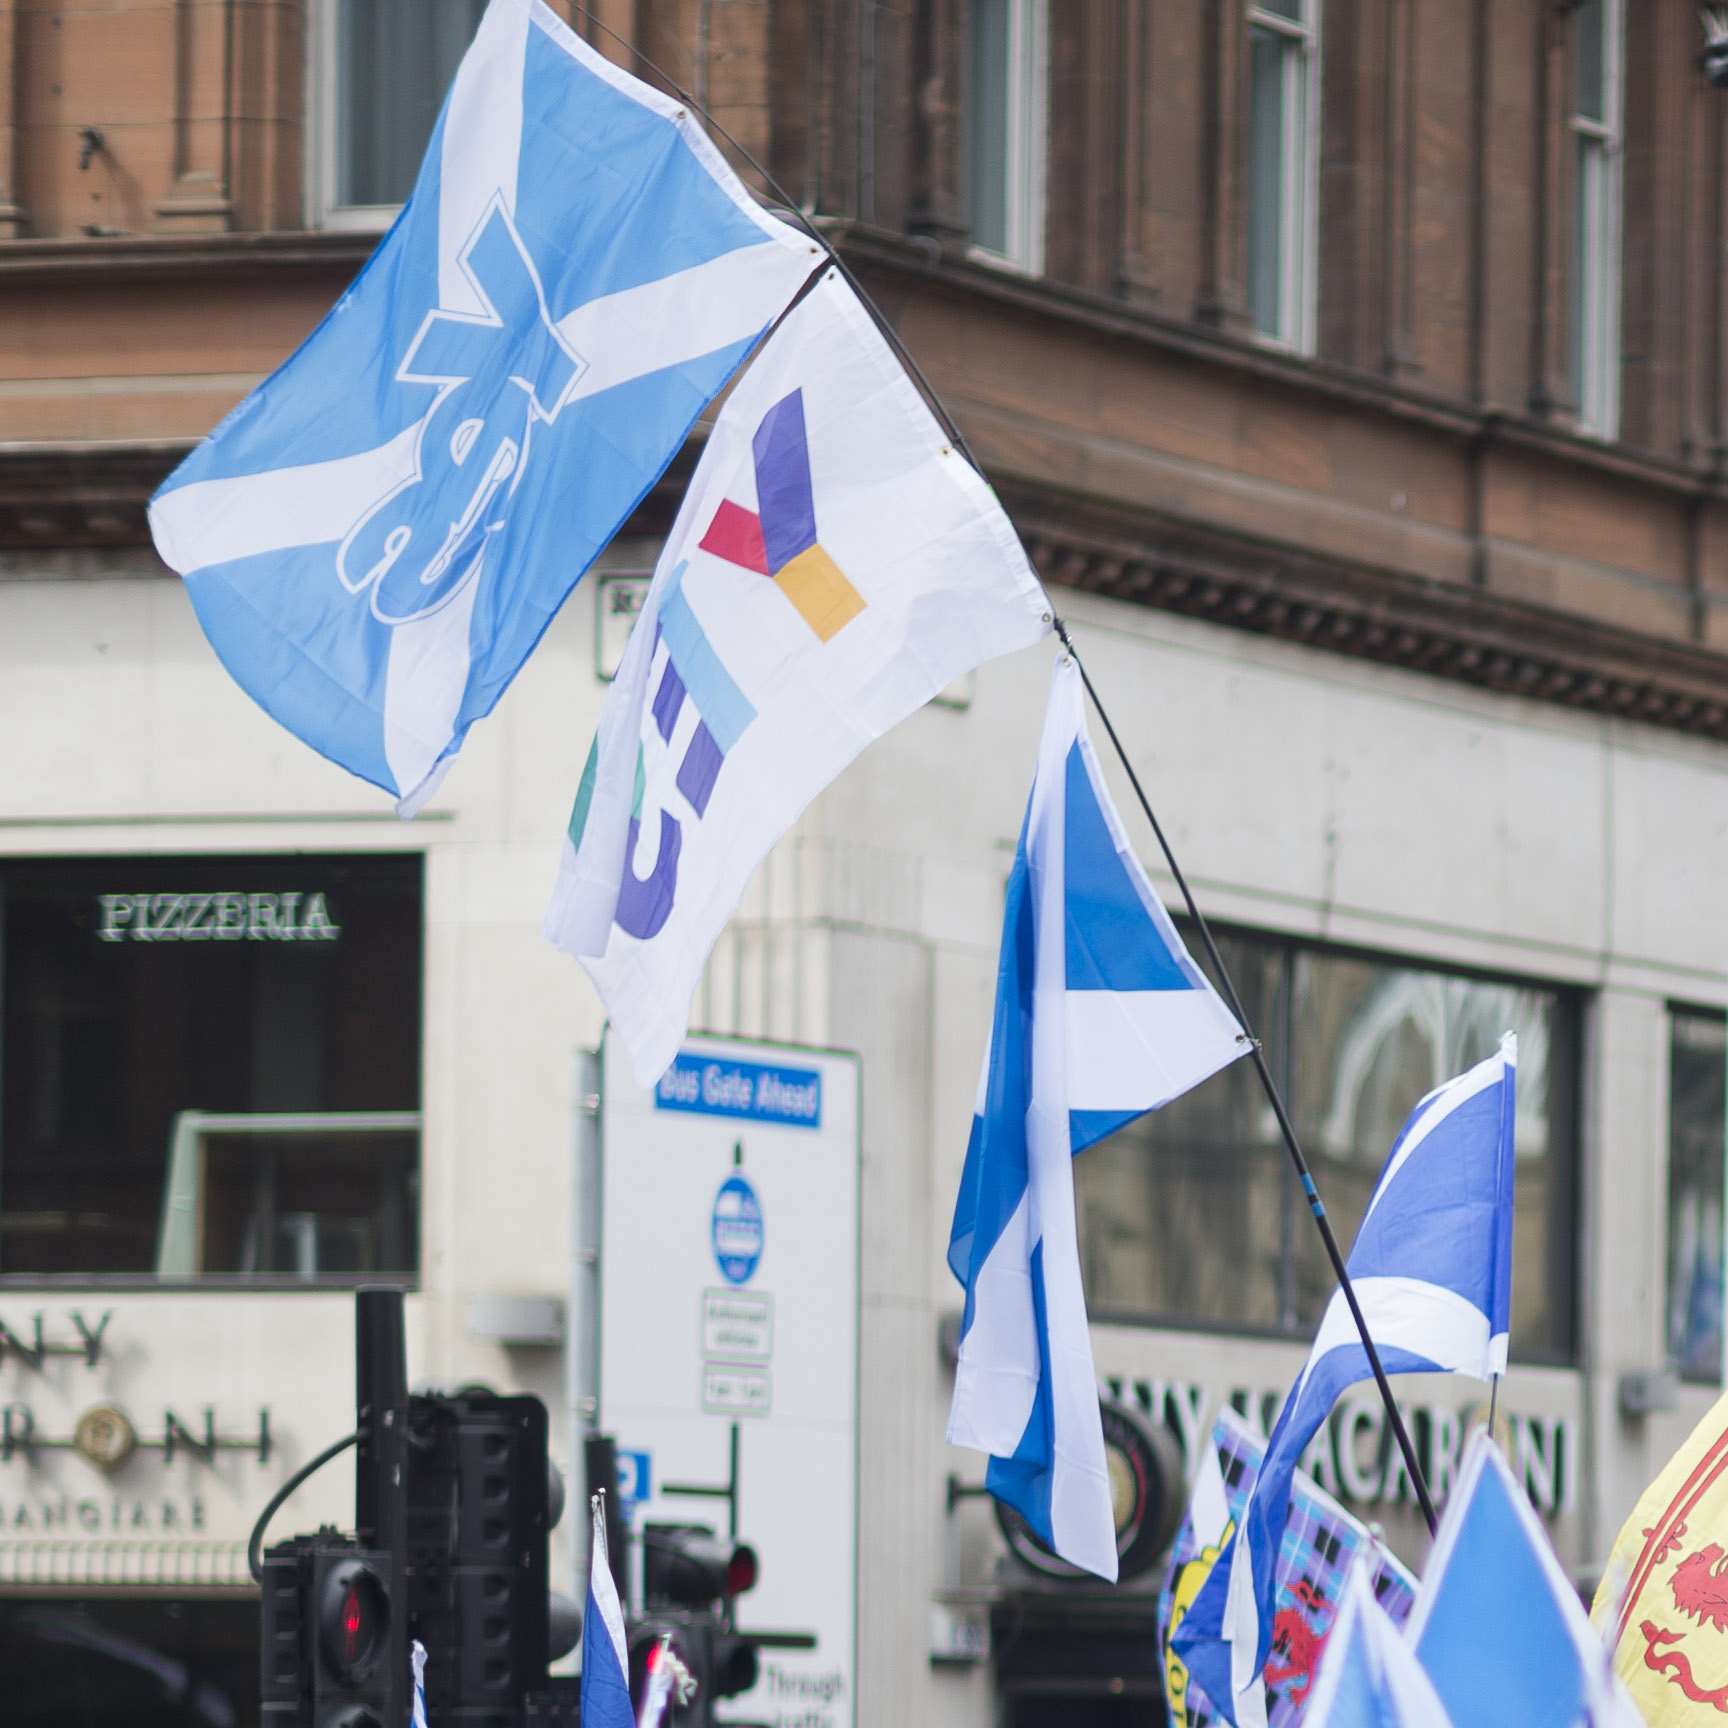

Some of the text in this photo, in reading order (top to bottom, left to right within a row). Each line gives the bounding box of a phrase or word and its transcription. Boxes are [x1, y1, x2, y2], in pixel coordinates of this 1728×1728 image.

[97, 891, 341, 942] PIZZERIA
[702, 1063, 753, 1110] Gate
[755, 1069, 819, 1119] Ahead
